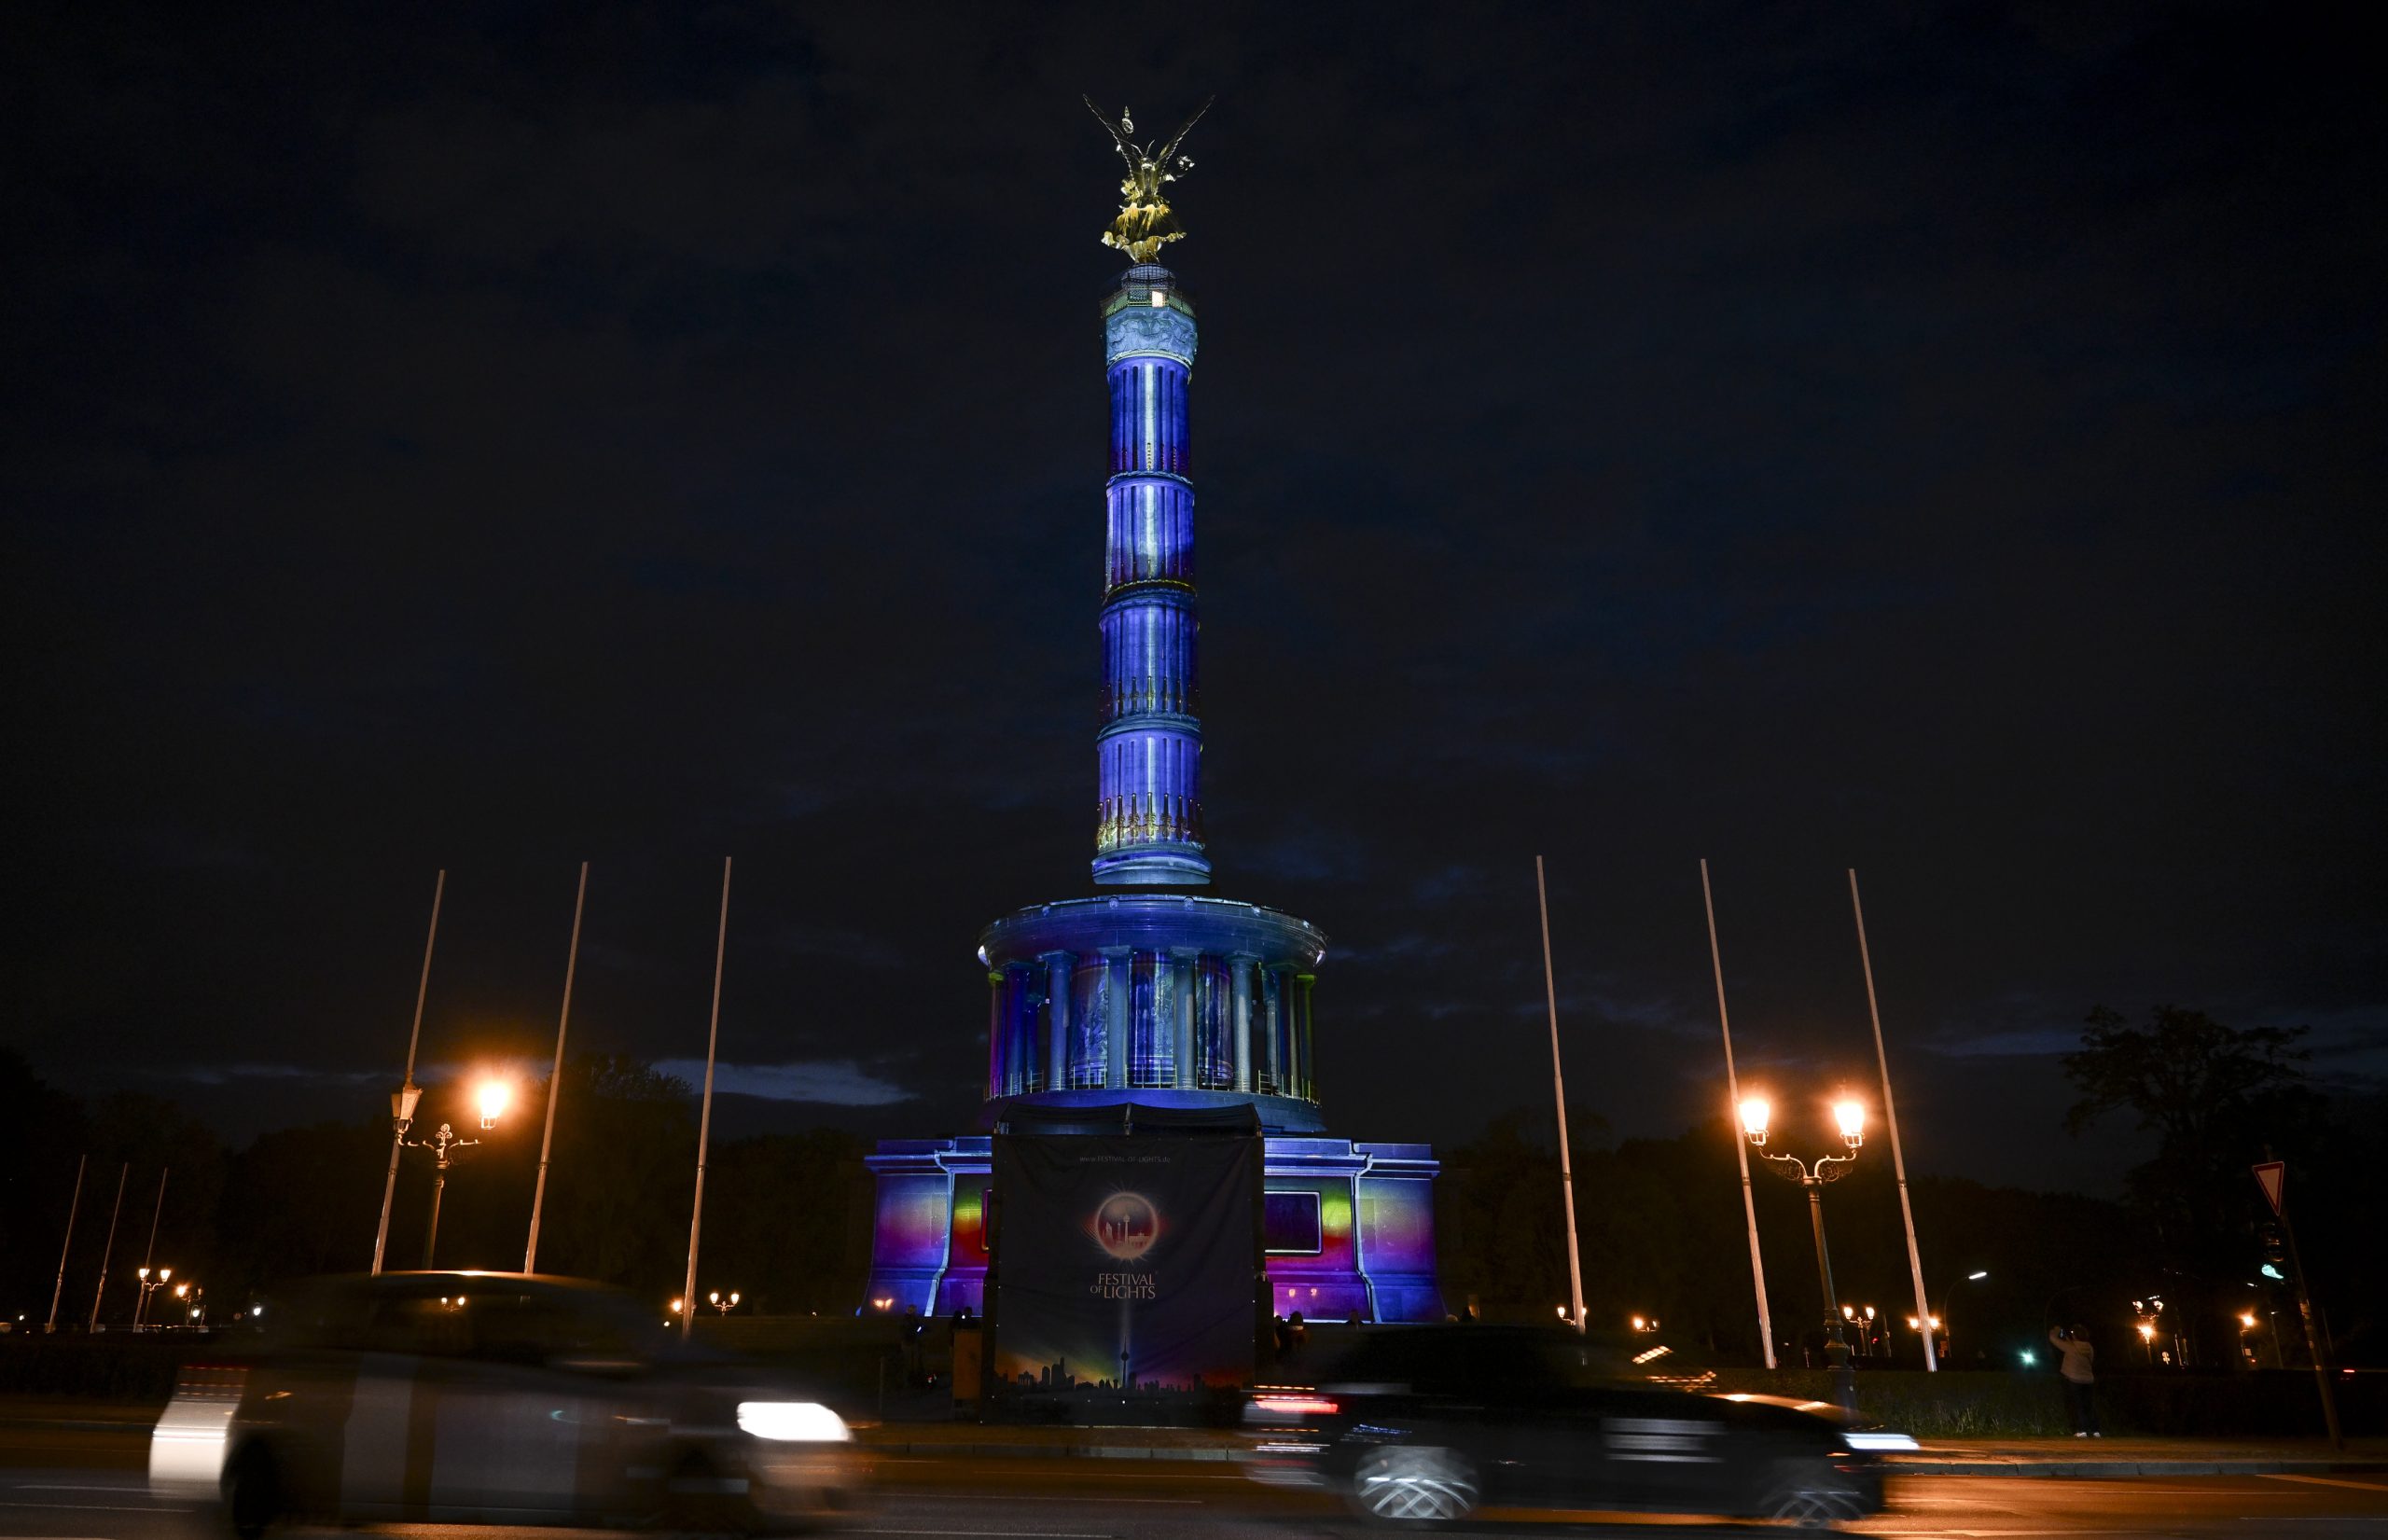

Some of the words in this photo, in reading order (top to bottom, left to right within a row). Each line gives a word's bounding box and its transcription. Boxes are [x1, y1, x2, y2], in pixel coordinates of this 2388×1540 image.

[1098, 1273, 1156, 1286] FESTIVAL
[1090, 1285, 1104, 1295] OF
[1104, 1285, 1157, 1299] LIGHTS
